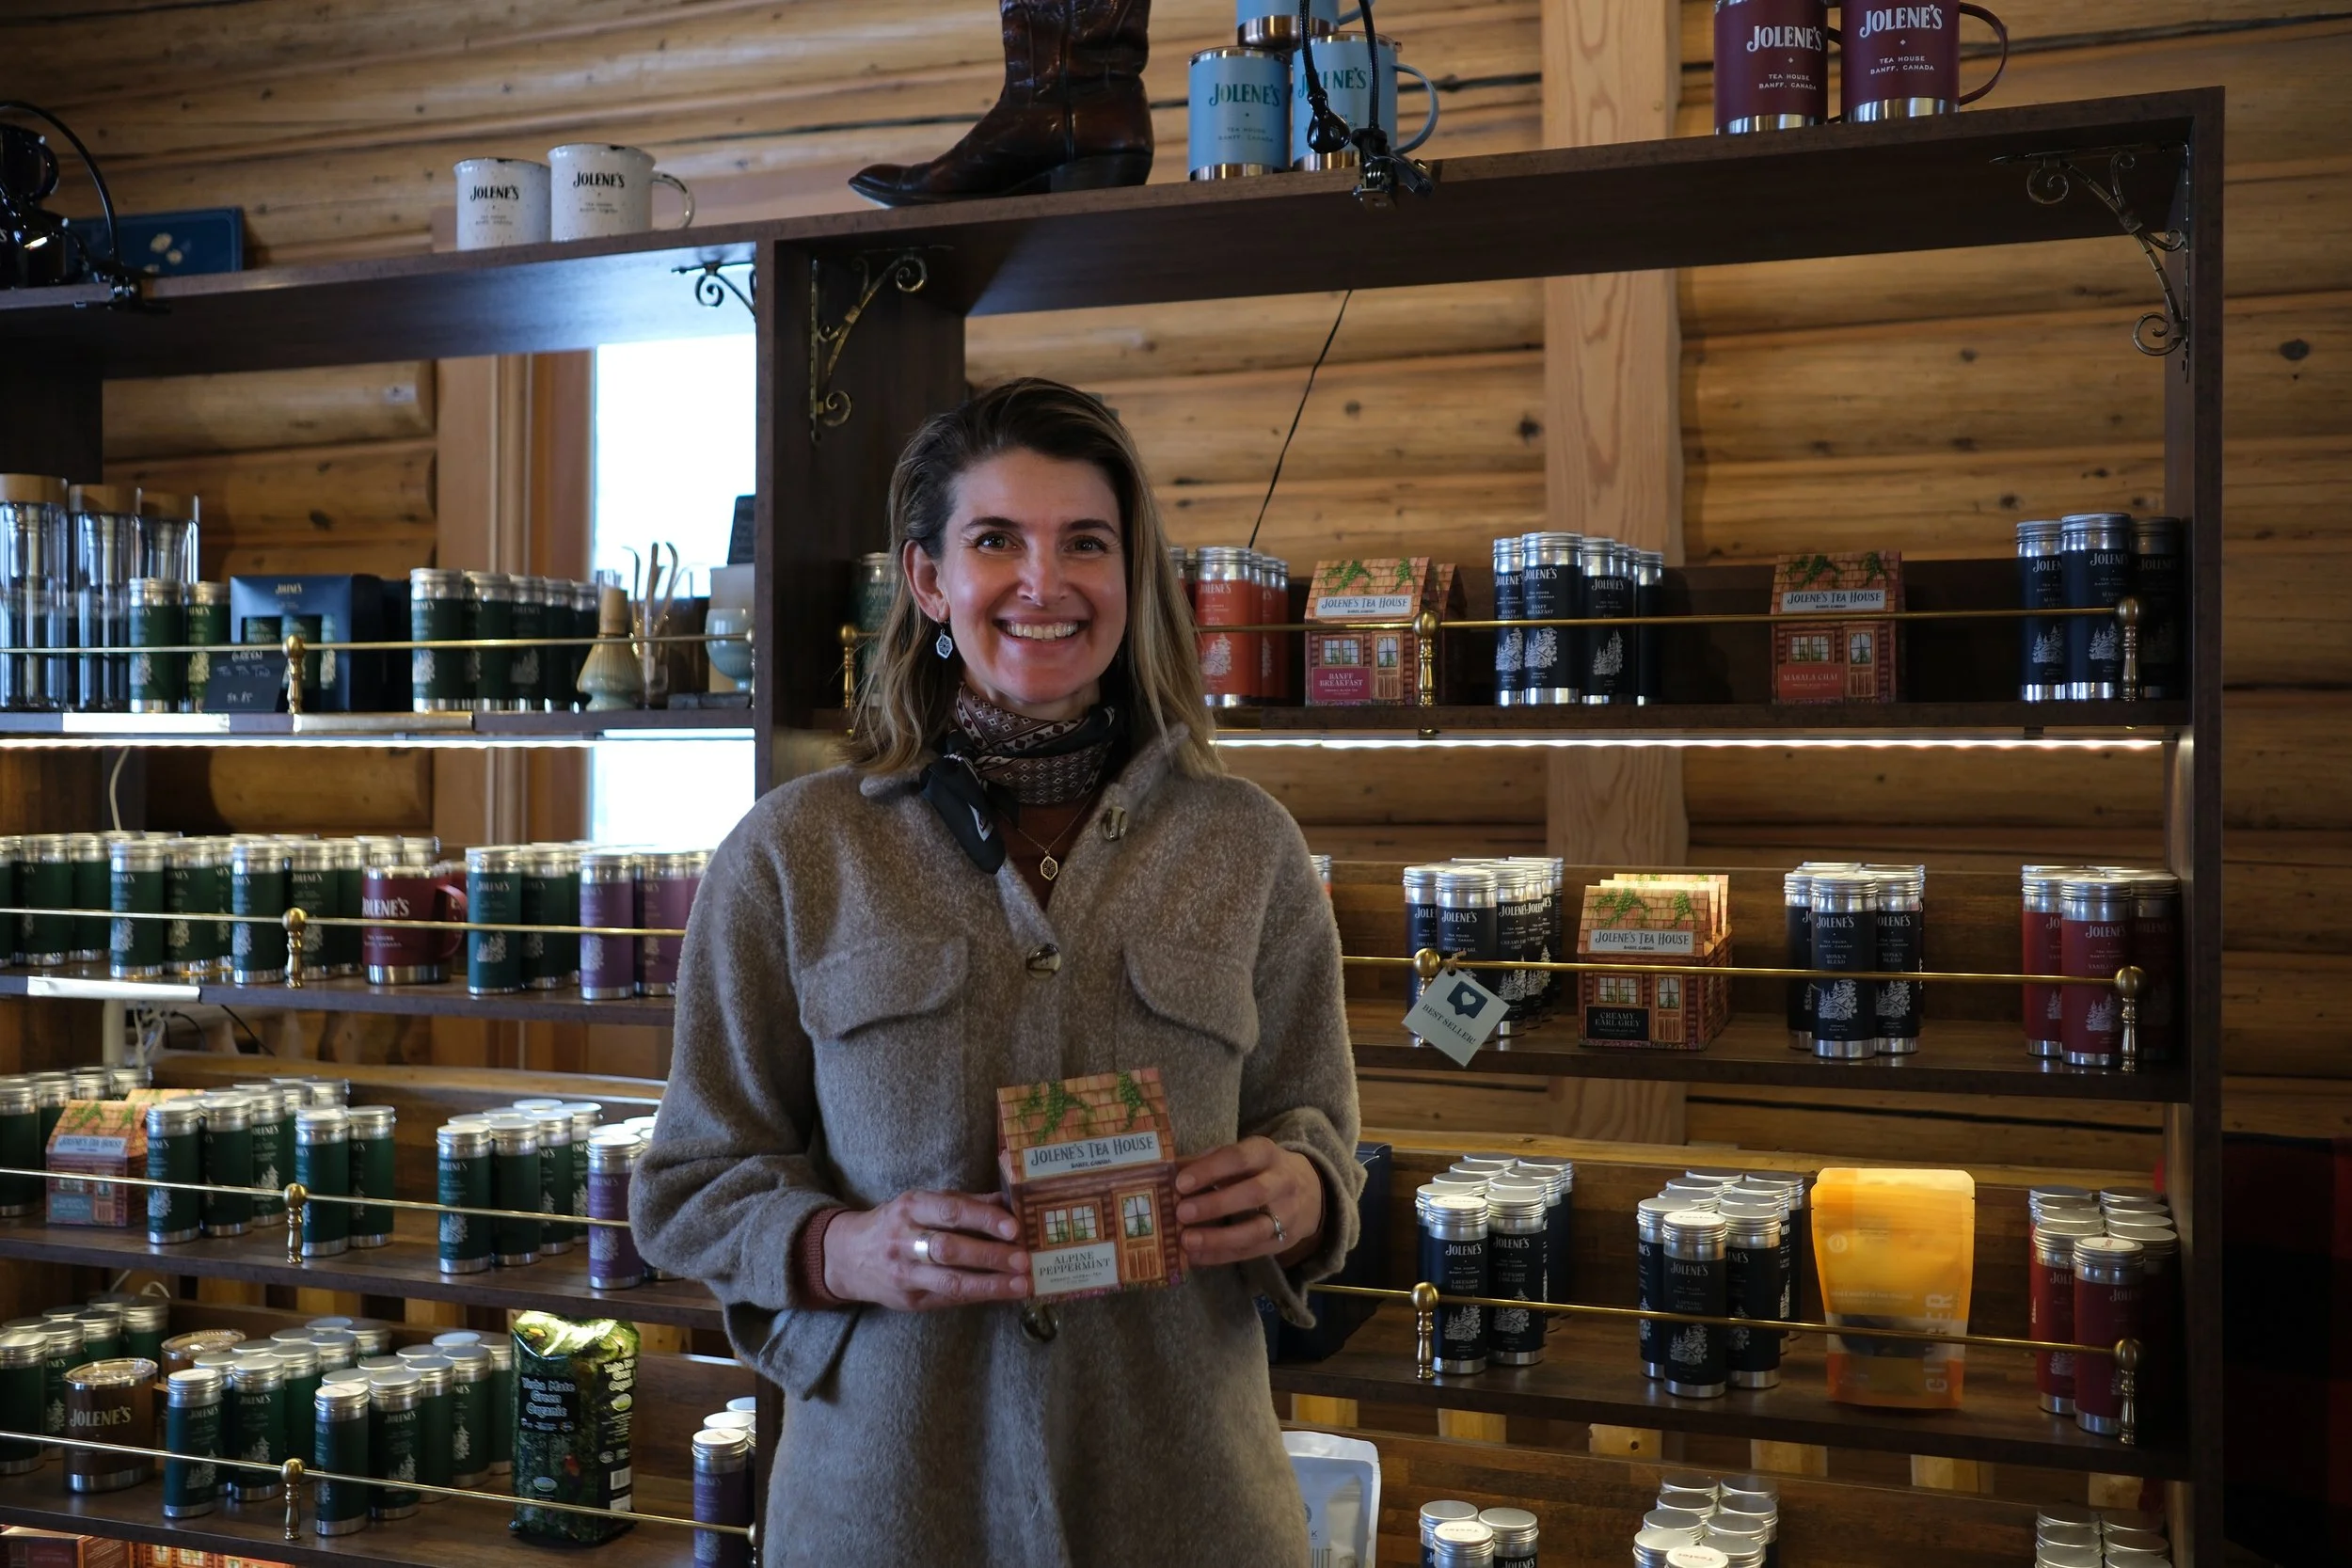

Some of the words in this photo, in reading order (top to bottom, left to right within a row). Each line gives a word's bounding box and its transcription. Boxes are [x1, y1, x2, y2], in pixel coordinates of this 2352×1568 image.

[1859, 4, 1943, 39] JOLENE'S
[1746, 25, 1822, 53] JOLENE'S
[1902, 64, 1935, 72] CANADA
[1787, 73, 1810, 82] HOUSE
[1790, 82, 1817, 91] CANADA
[1208, 83, 1280, 107] JOLENE'S
[573, 171, 625, 188] JOLENE'S
[470, 184, 519, 202] JOLENE'S
[2033, 560, 2062, 573] JOLEN
[1525, 567, 1557, 581] JOLENE'S
[1322, 597, 1359, 610] JOLENE'S
[1361, 598, 1375, 609] TEA
[1379, 597, 1407, 608] HOUSE
[1788, 592, 1828, 605] JOLENE'S
[1831, 592, 1847, 603] TEA
[1850, 592, 1882, 603] HOUSE
[361, 896, 410, 918] OLENE'S
[1441, 911, 1478, 924] JOLENE'S
[1816, 915, 1855, 929] JOLENE'S
[1877, 914, 1911, 927] OLENE'S
[1596, 931, 1636, 943] JOLENE'S
[1639, 932, 1655, 944] TEA
[1658, 932, 1689, 946] HOUSE
[1422, 1003, 1444, 1022] BEST
[1441, 1018, 1476, 1046] SELLER!
[1031, 1144, 1084, 1166] JOLENE'S
[1088, 1141, 1109, 1159] TEA
[1112, 1135, 1154, 1156] HOUSE
[1445, 1243, 1482, 1256] JOLENE'S
[1494, 1237, 1530, 1249] JOLENE'S
[1054, 1251, 1094, 1265] ALPINE
[1040, 1258, 1111, 1276] PEPPERMINT
[1670, 1261, 1708, 1277] JOLENE'S
[70, 1405, 132, 1428] JOLENE'S
